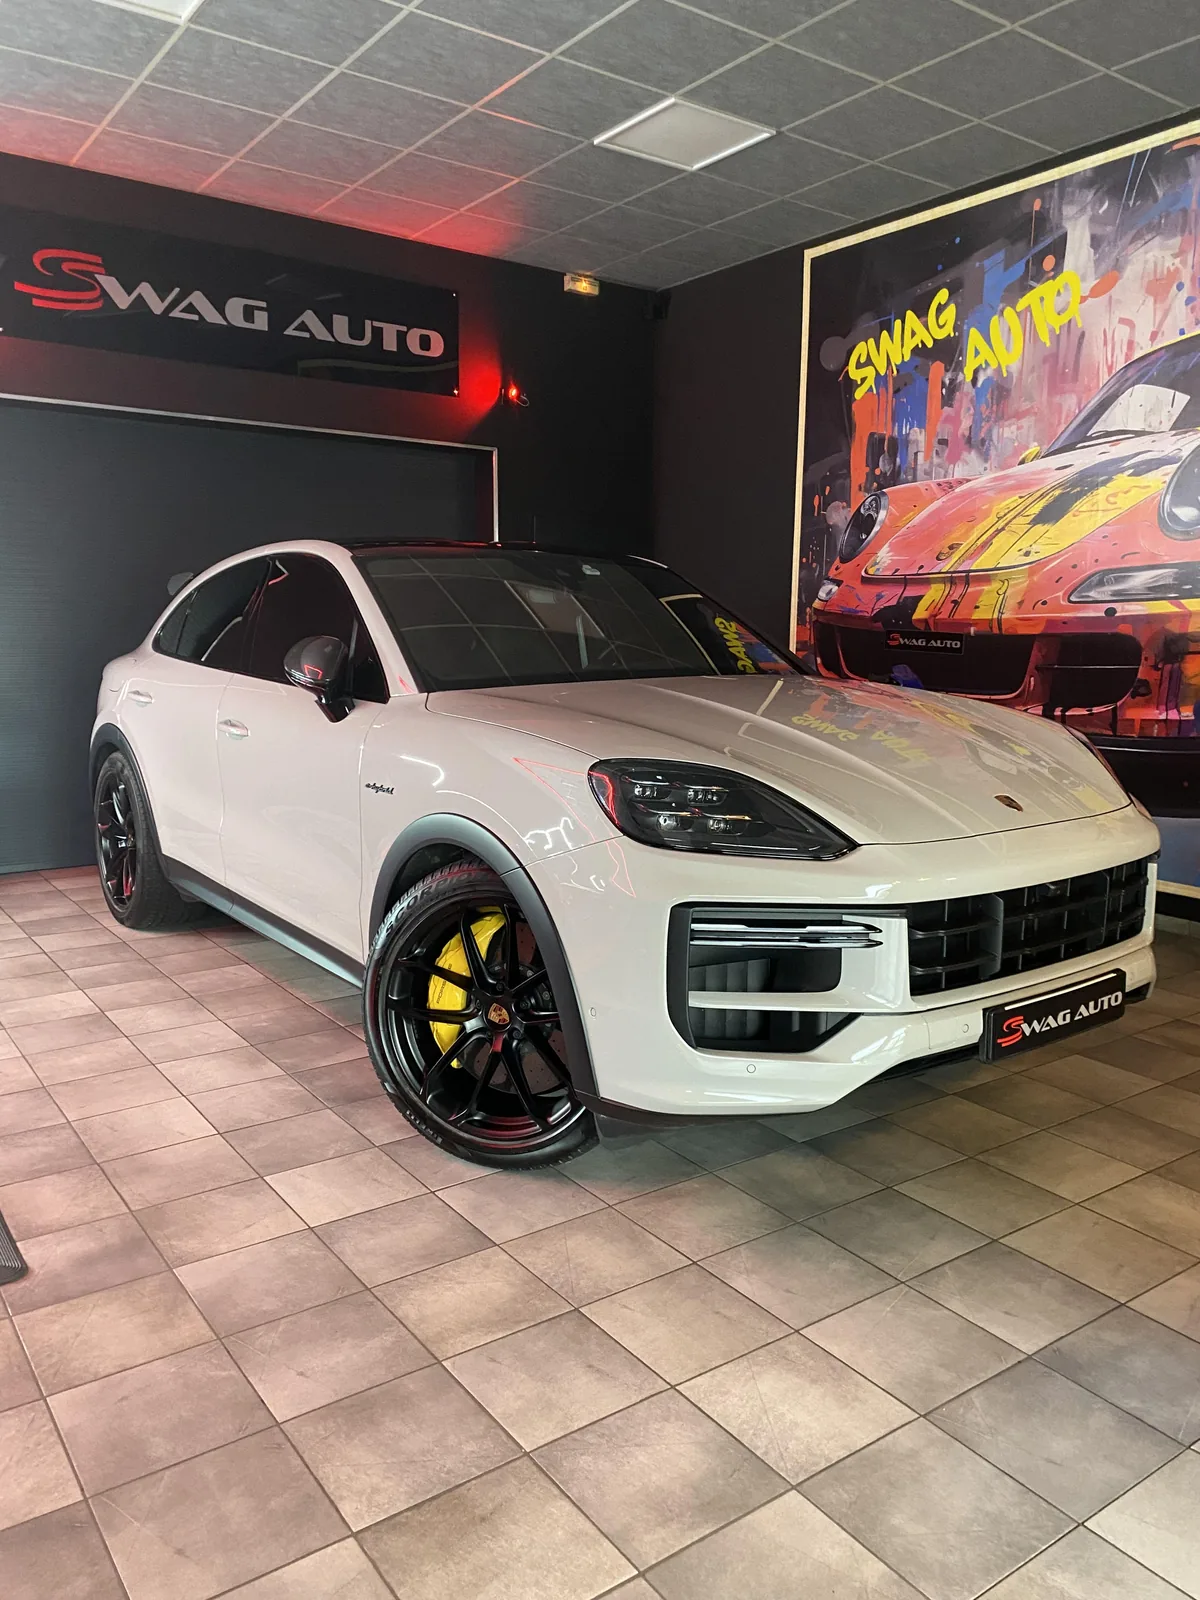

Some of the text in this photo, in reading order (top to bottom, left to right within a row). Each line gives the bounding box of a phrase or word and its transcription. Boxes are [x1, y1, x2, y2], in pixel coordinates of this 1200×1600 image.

[14, 248, 444, 358] SWAG AUTO
[848, 270, 1082, 400] SWAG AUTO
[887, 633, 961, 648] SWAG AUTO
[996, 991, 1123, 1047] SWAG AUTO
